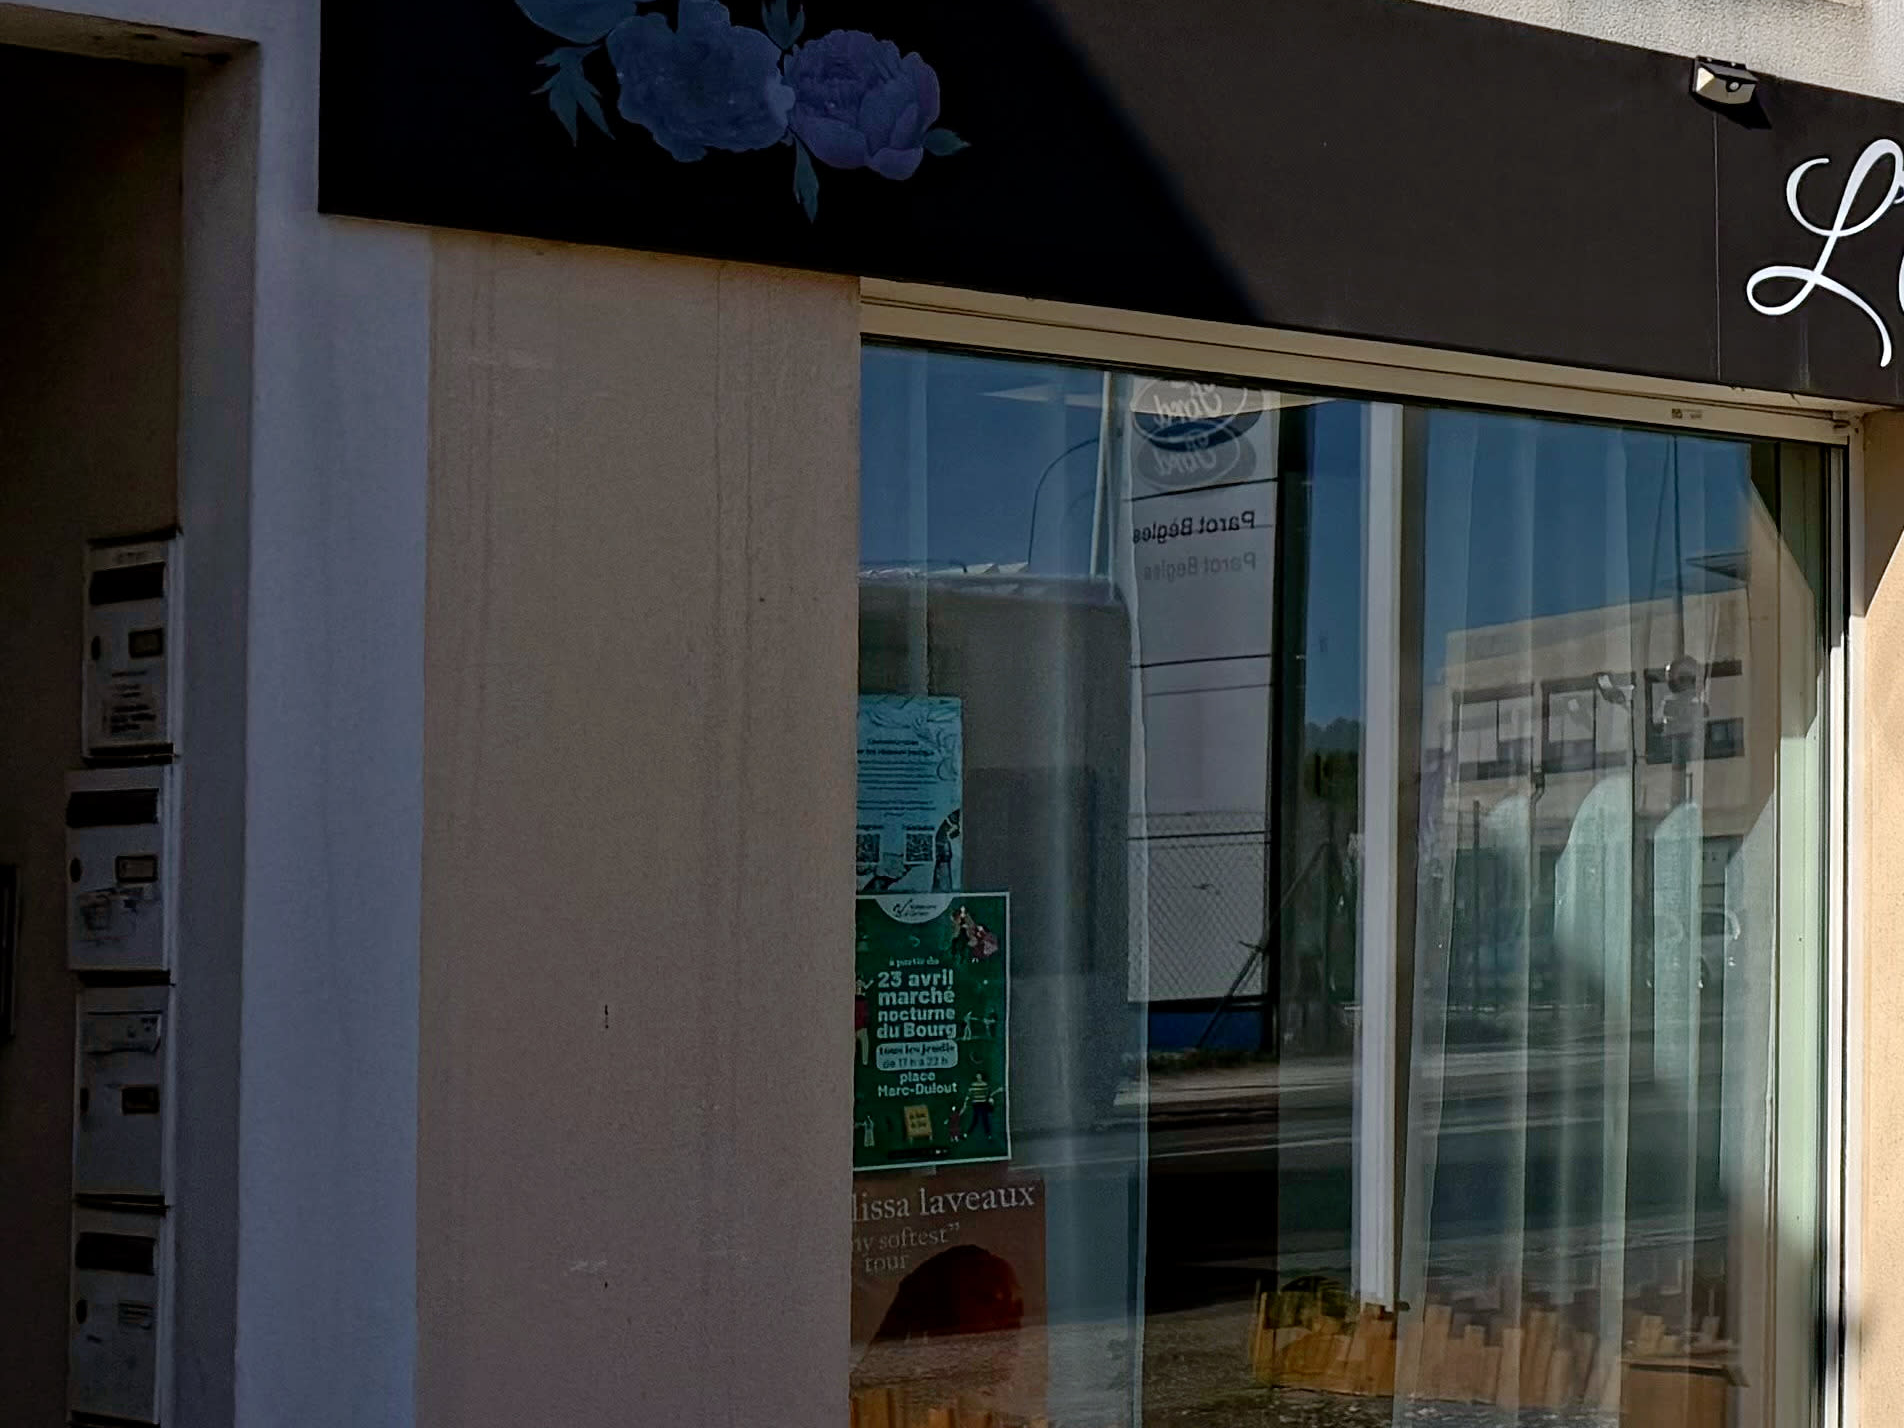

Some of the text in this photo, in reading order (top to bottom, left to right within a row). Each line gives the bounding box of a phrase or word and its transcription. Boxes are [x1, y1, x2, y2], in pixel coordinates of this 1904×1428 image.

[878, 969, 953, 988] 23 avril
[878, 987, 955, 1006] marché
[878, 1007, 955, 1022] nocturne
[876, 1022, 957, 1039] du Bourg
[899, 1071, 935, 1085] place
[852, 1185, 1035, 1221] lissa laveaux
[864, 1254, 910, 1272] tour
